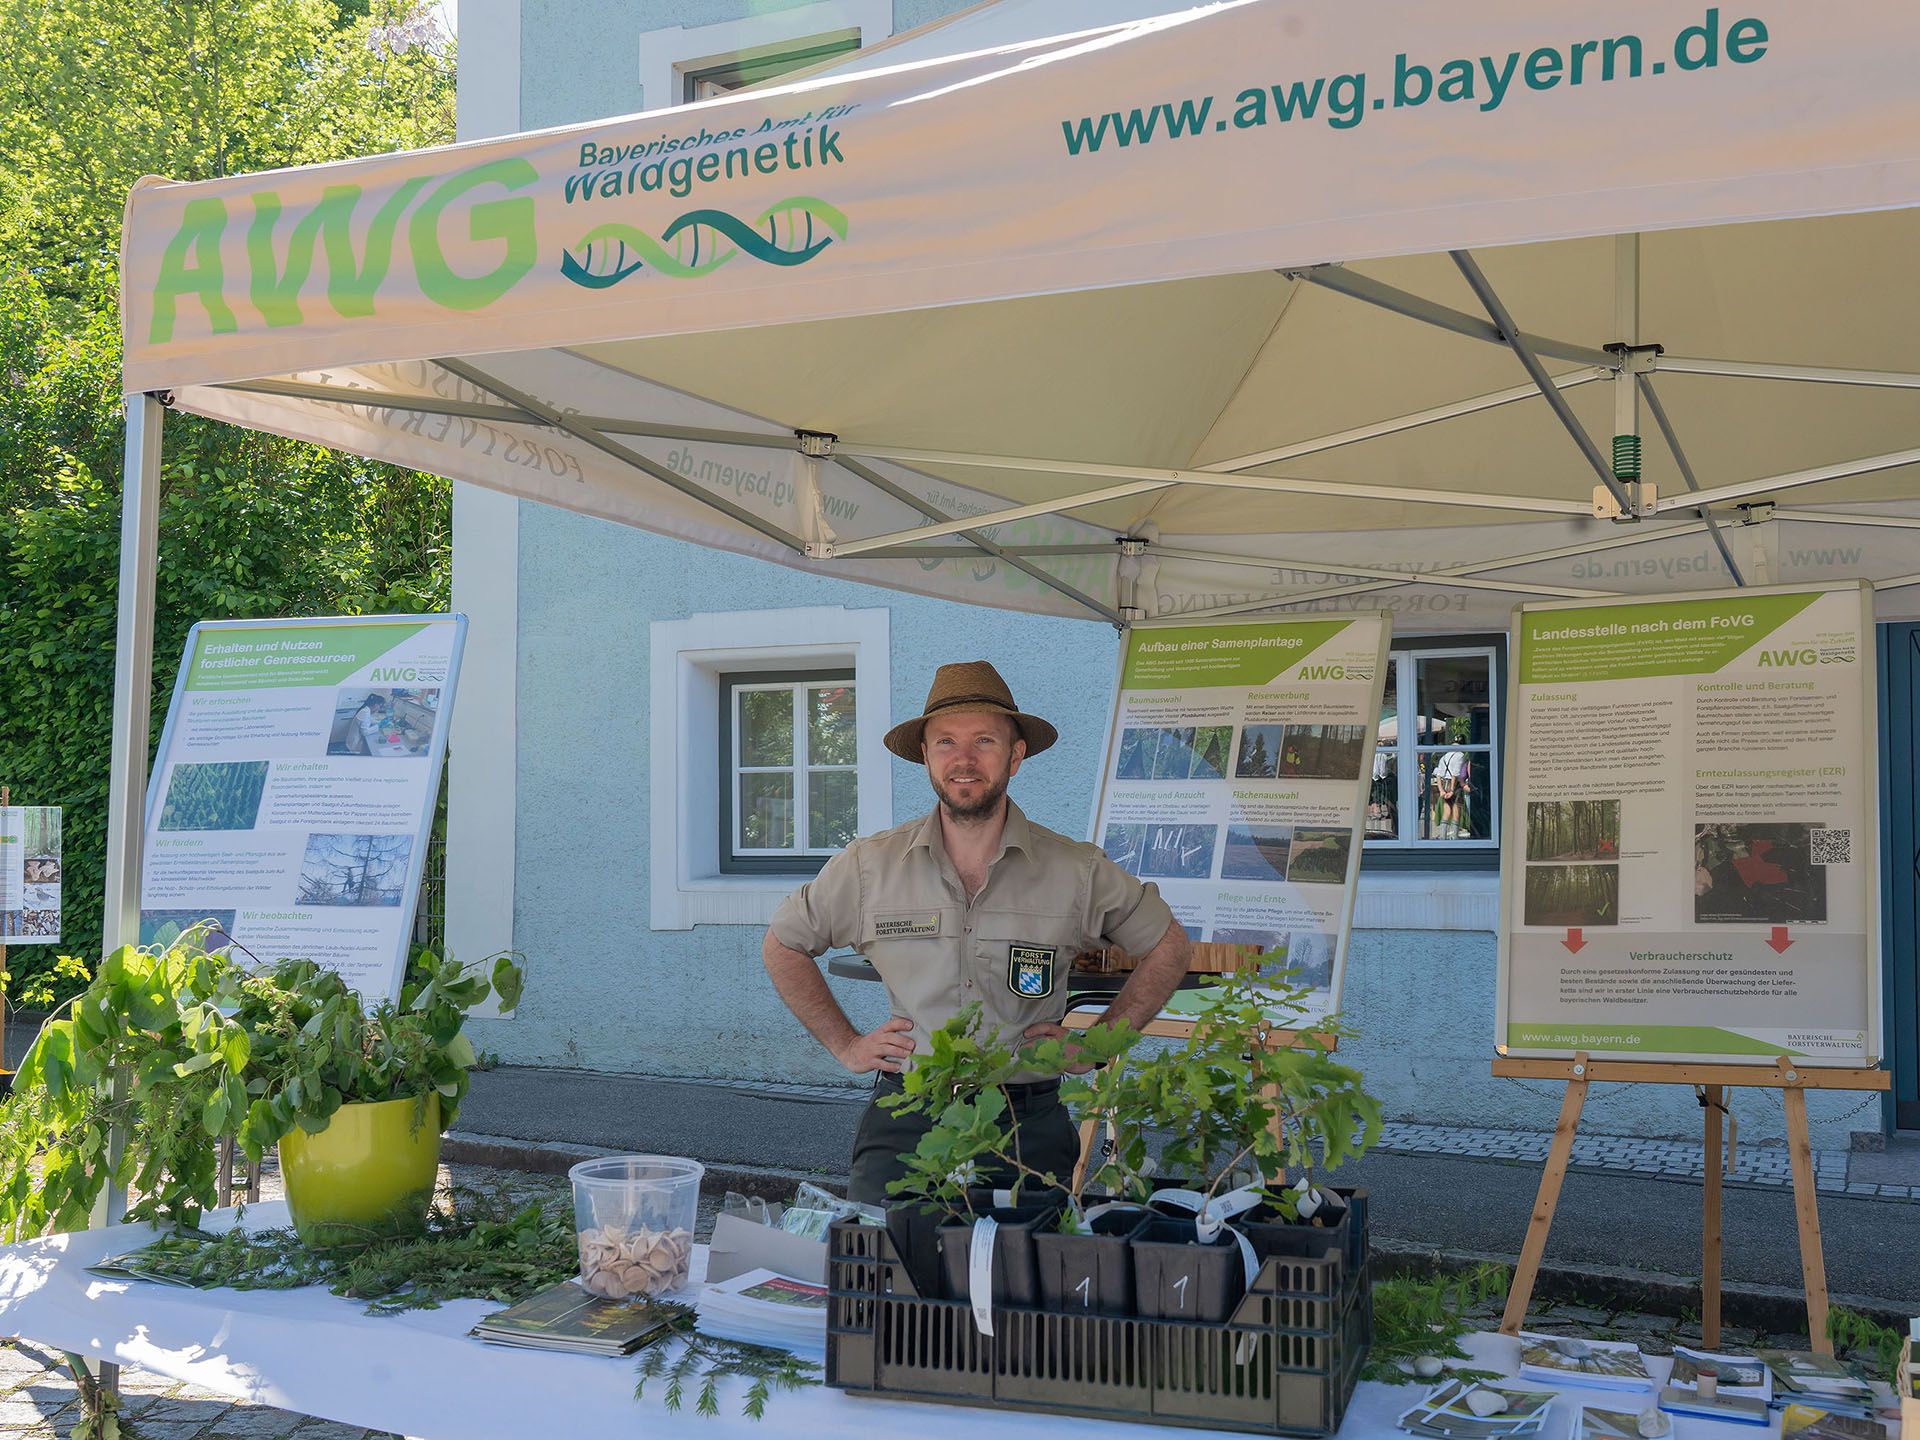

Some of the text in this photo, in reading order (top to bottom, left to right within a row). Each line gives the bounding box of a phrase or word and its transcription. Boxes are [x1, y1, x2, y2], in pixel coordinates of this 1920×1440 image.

[1061, 8, 1770, 156] www.awg.bayern.de
[579, 103, 862, 169] Bayerisches Amt für
[564, 124, 844, 204] Waldgenetik
[149, 158, 540, 344] AWG
[1532, 614, 1755, 641] Landesstelle nach dem FoVG
[204, 640, 323, 655] Erhalten und Nutzen
[1138, 636, 1303, 653] Aufbau einer Samenplantage
[199, 653, 357, 669] forstlicher Genressourcen
[1758, 648, 1818, 667] AWG
[369, 667, 417, 682] AWG
[1298, 665, 1344, 680] AWG
[1696, 681, 1814, 692] Kontrolle und Beratung
[1128, 695, 1182, 704] Baumauswahl
[1248, 691, 1310, 701] Reiserwerbung
[1531, 693, 1577, 703] Zulassung
[192, 697, 207, 706] Wir
[275, 763, 328, 771] Wir erhalten
[1696, 766, 1846, 779] Erntezulassungsregister (EZR)
[1112, 791, 1157, 801] Veredelung
[1173, 792, 1205, 800] Anzucht
[1232, 790, 1299, 800] Flächenauswahl
[155, 839, 203, 847] Wir fördern
[1217, 892, 1287, 904] Pflege und Ernte
[242, 911, 313, 920] Wir beobachten
[875, 920, 913, 929] BAYERISCHE
[875, 925, 936, 936] FORSTVERWALTUNG
[1020, 951, 1044, 959] FORST
[1629, 951, 1733, 961] Verbraucherschutz
[1013, 956, 1050, 966] VERWALTUNG
[1598, 968, 1661, 977] gesetzeskonforme
[1662, 968, 1700, 977] Zulassung
[1729, 969, 1777, 978] gesündesten
[1705, 978, 1756, 987] Überwachung
[1606, 987, 1614, 995] in
[1615, 987, 1636, 995] erster
[1672, 988, 1770, 996] Verbraucherschutzbehörde
[1559, 996, 1601, 1005] bayerischen
[1521, 1032, 1641, 1046] www.awg.bayern.de
[1786, 1033, 1834, 1041] BAYERISCHE
[1786, 1040, 1863, 1049] FORSTVERWALTUNG
[1075, 1276, 1090, 1307] 1
[1173, 1275, 1188, 1309] 1
